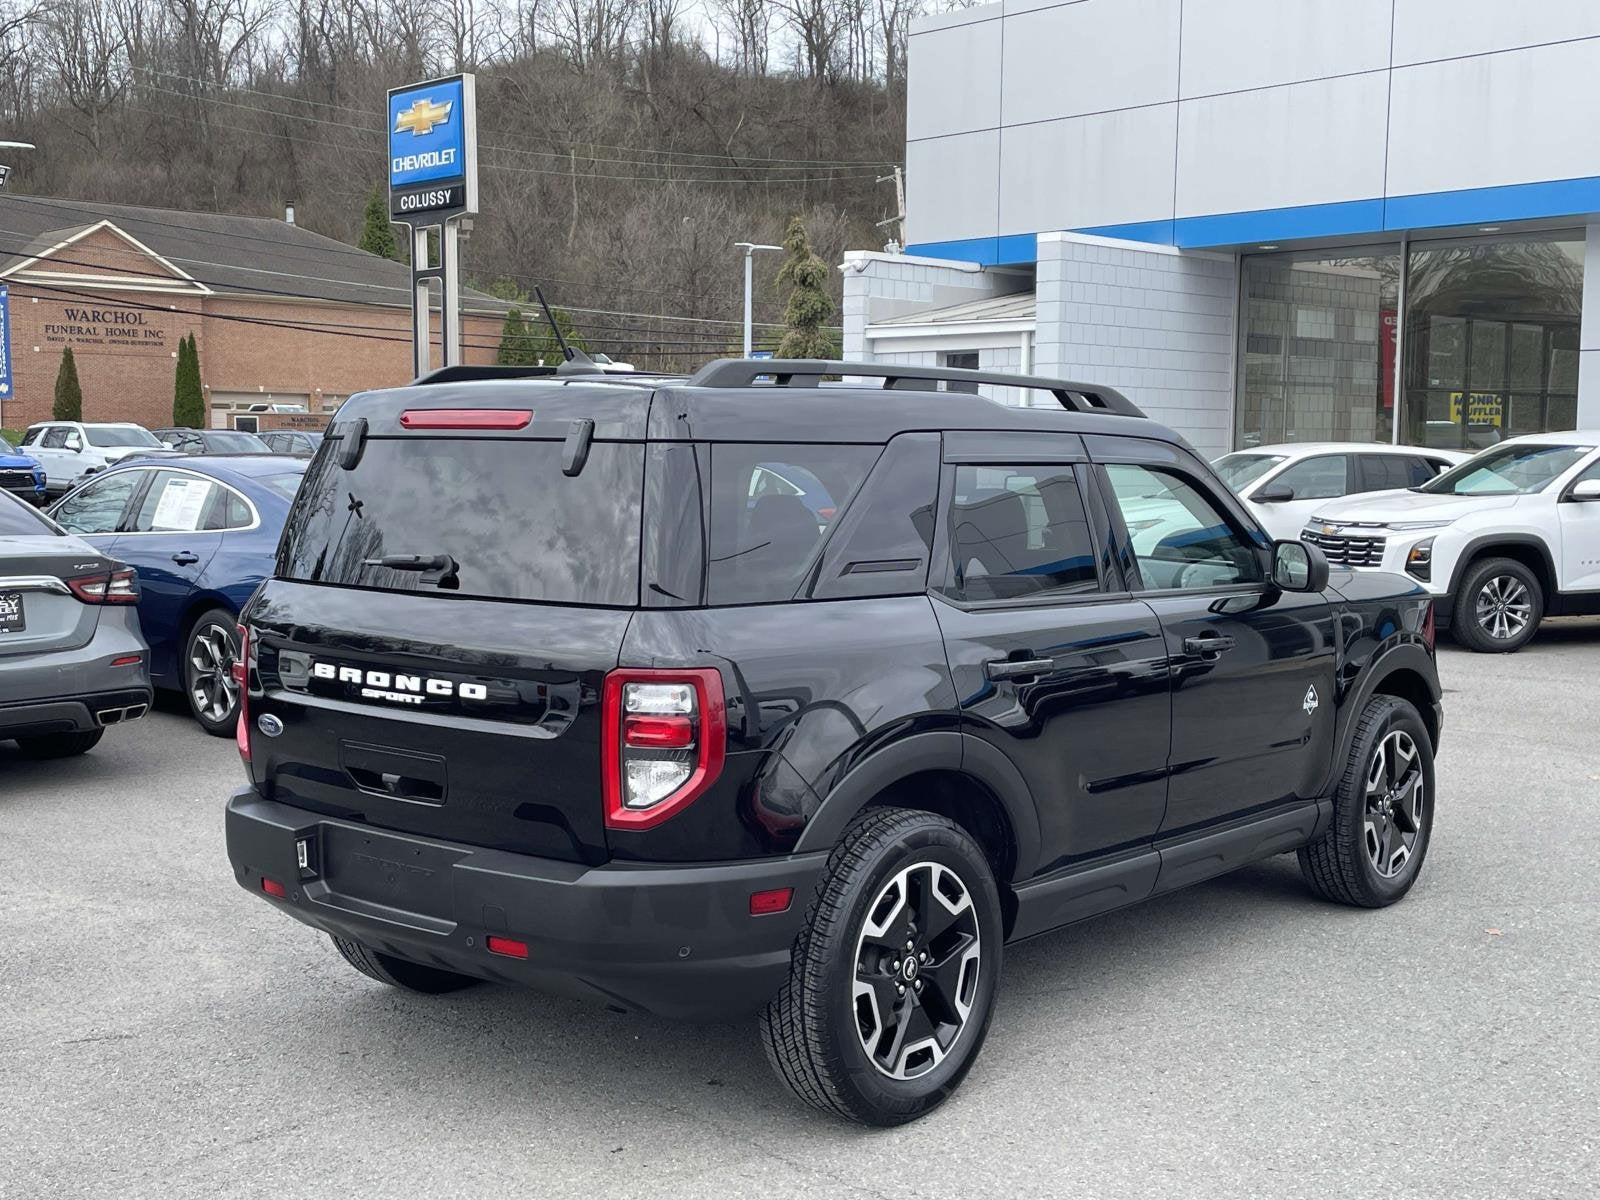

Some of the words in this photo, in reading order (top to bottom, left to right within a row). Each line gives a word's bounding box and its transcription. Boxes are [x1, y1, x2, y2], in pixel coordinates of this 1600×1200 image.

[393, 149, 456, 172] CHEVROLET
[401, 190, 451, 209] COLUSSY
[64, 308, 148, 325] WARCHOL
[45, 324, 99, 336] FUNERAL
[105, 327, 139, 338] HOME
[314, 662, 487, 700] BRONCO
[361, 688, 425, 704] SPORT
